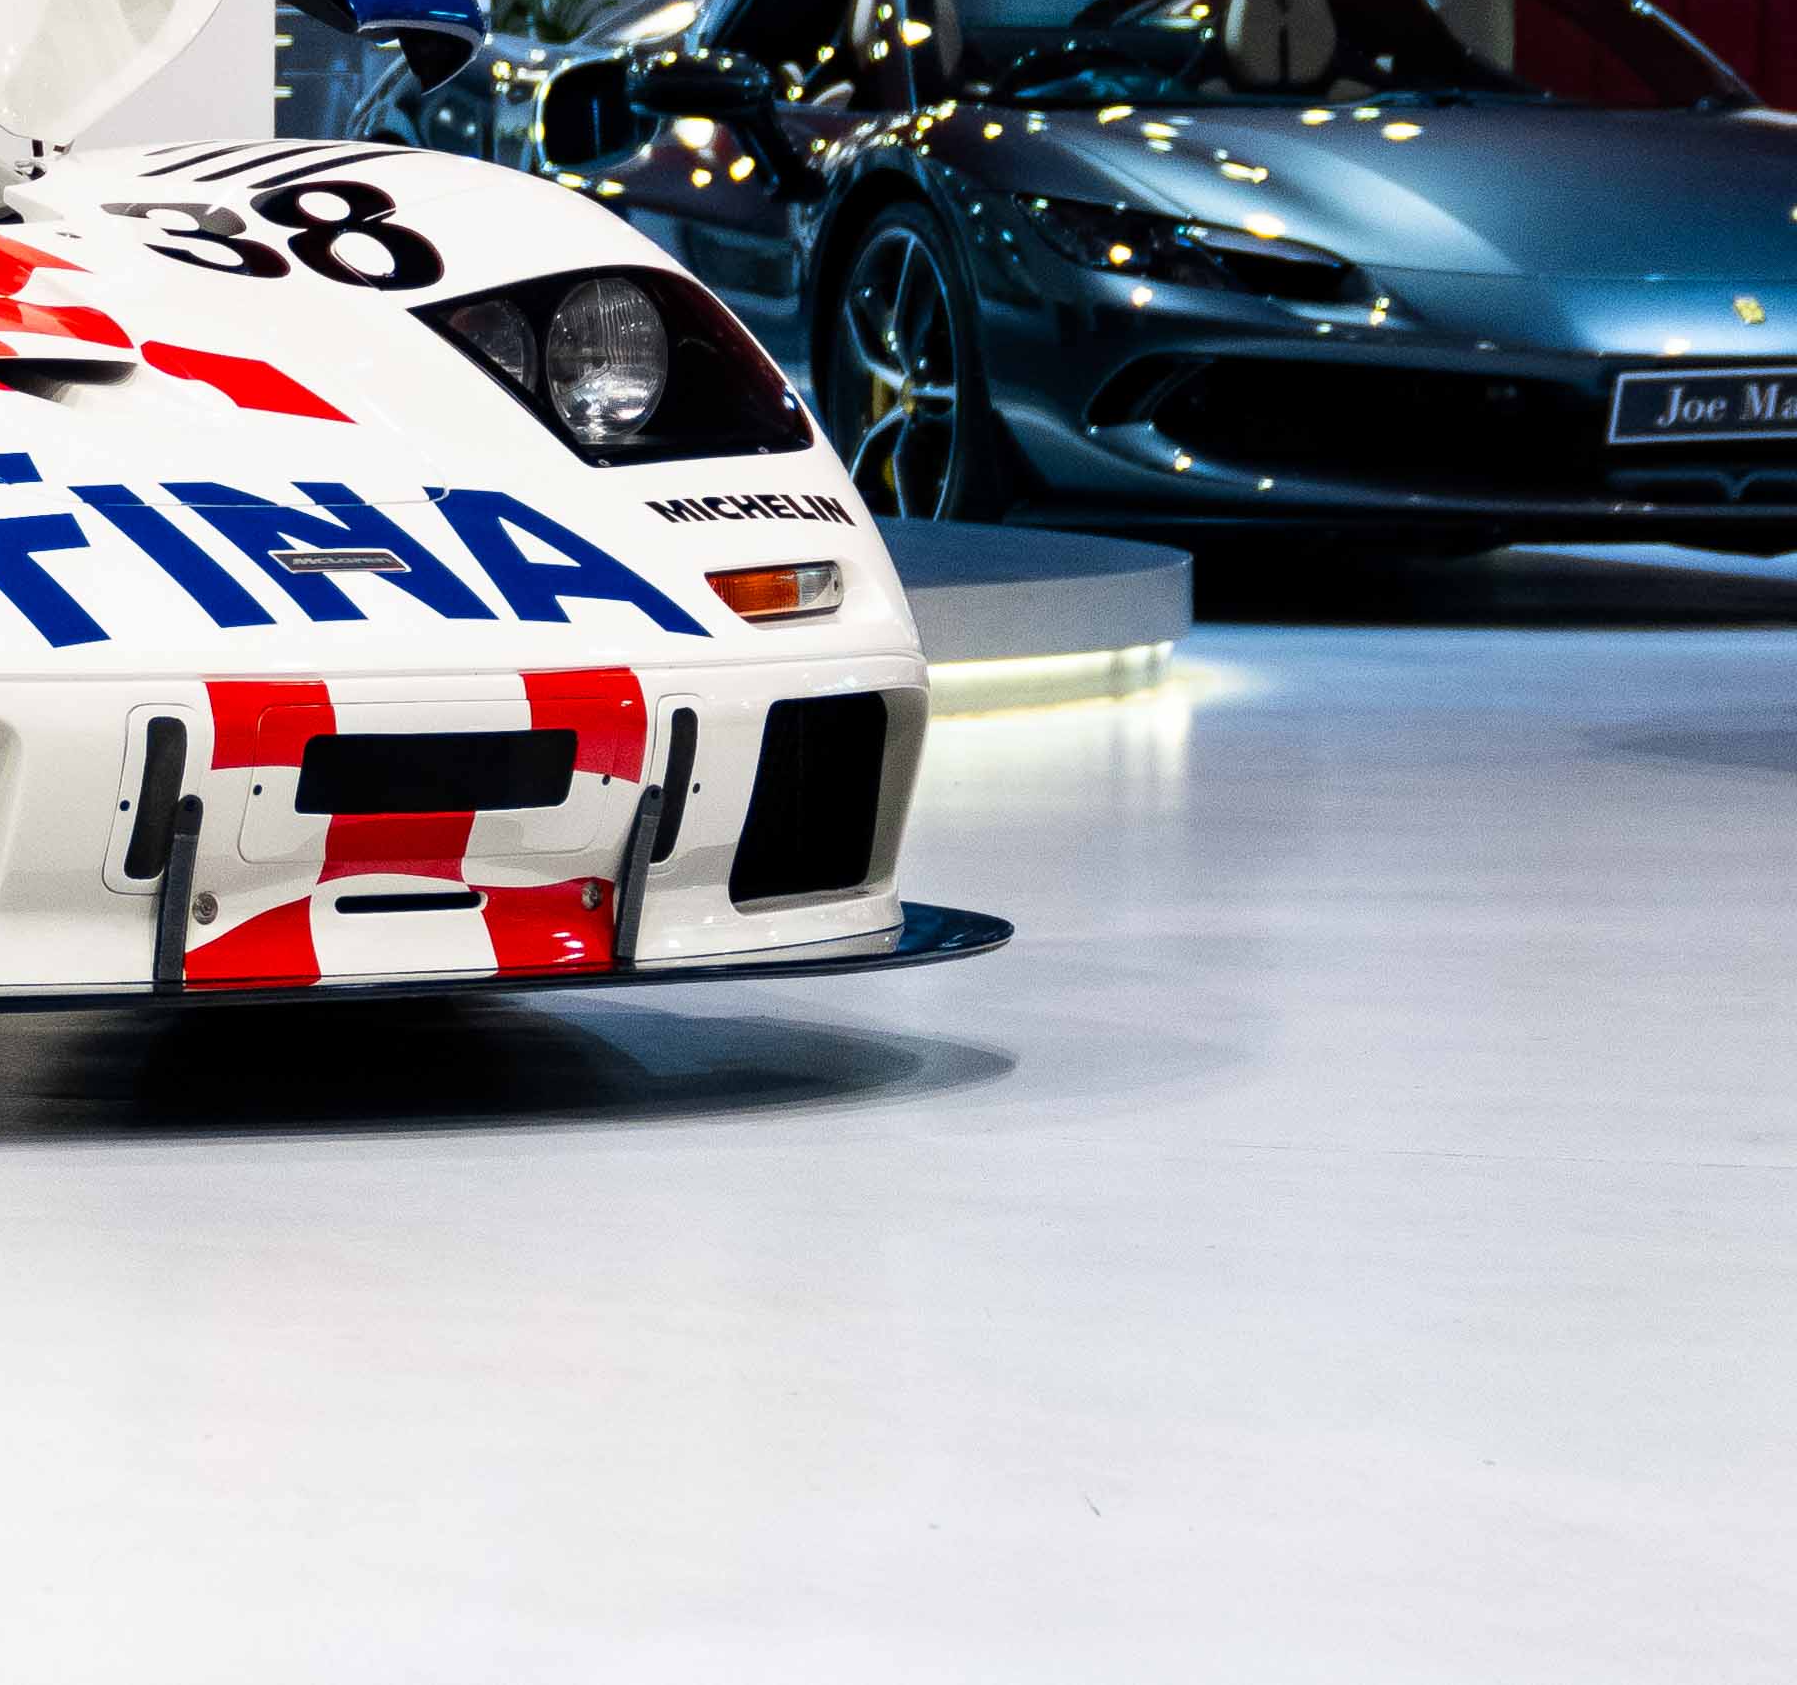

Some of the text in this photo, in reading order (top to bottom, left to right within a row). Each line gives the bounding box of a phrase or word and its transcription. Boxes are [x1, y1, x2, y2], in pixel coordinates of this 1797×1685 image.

[100, 179, 445, 292] 38
[1656, 382, 1729, 428] Joe
[645, 493, 857, 527] MICHELIN
